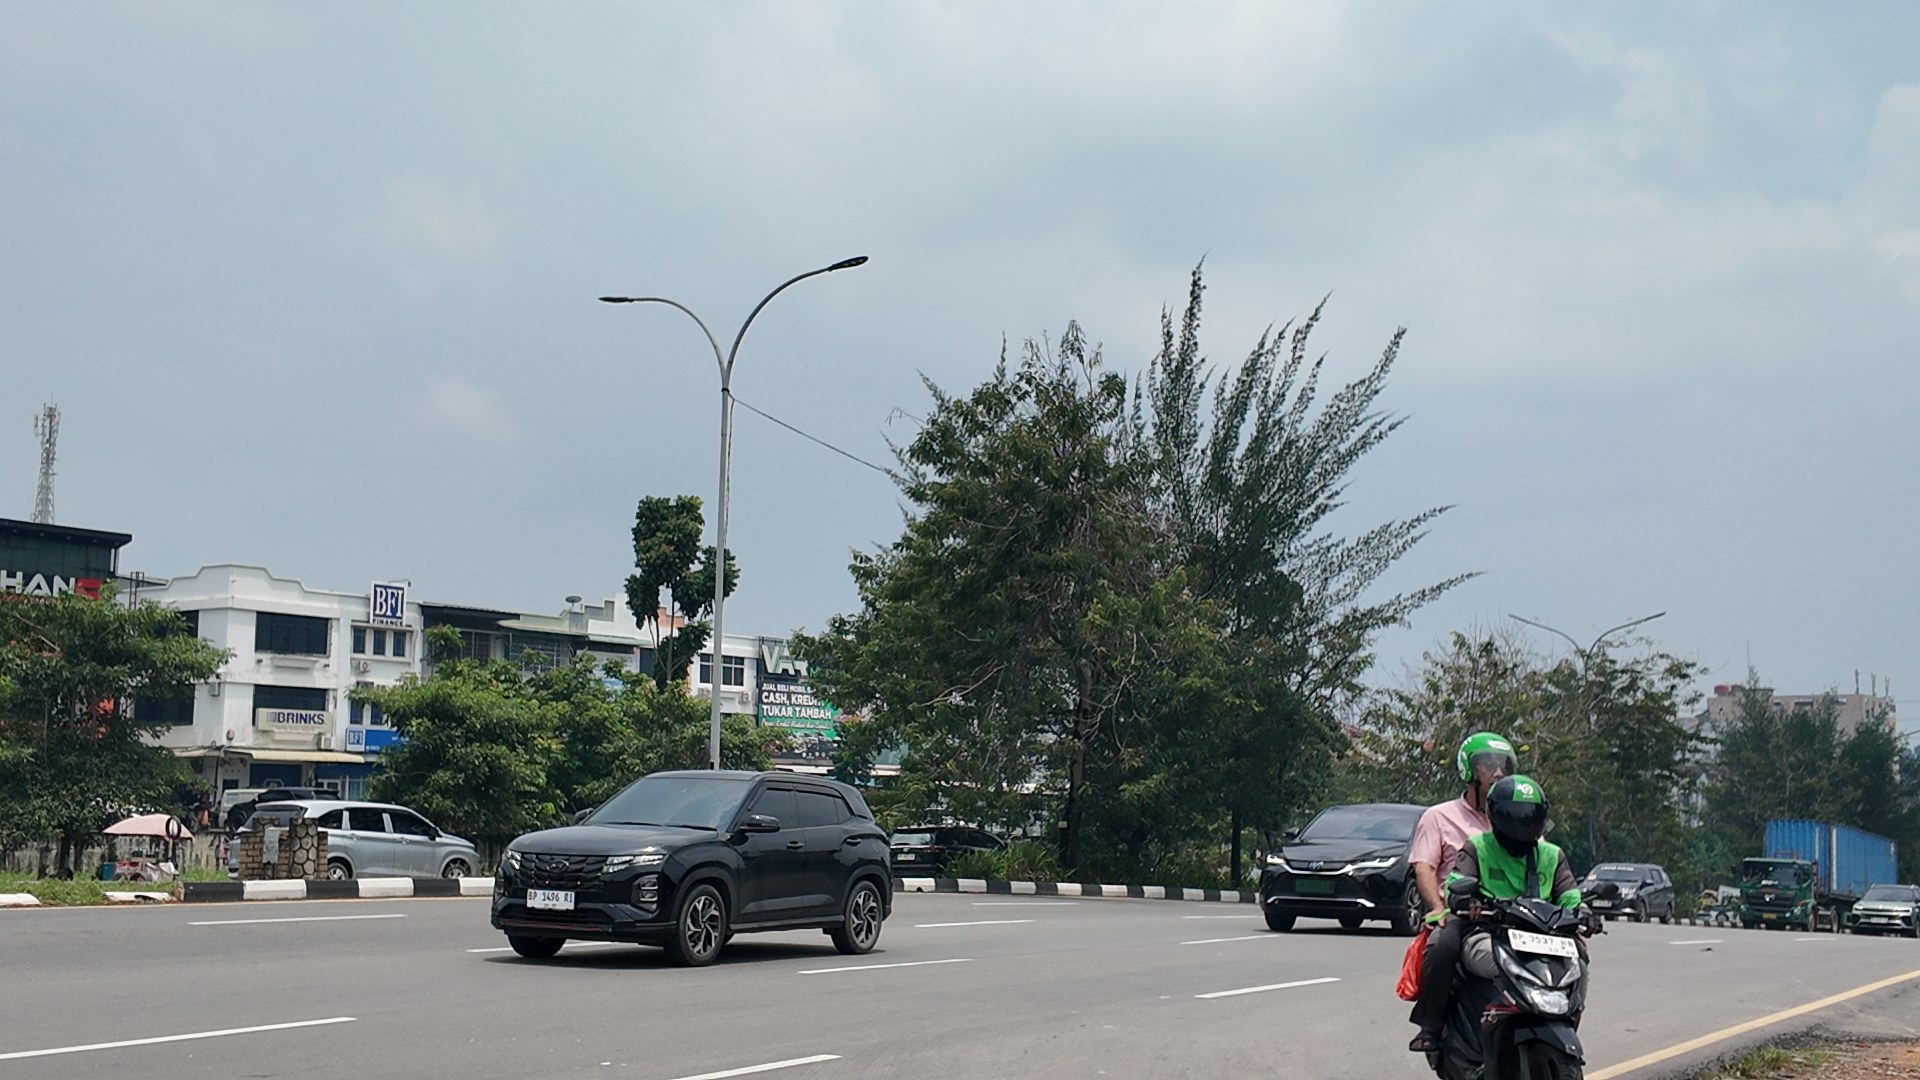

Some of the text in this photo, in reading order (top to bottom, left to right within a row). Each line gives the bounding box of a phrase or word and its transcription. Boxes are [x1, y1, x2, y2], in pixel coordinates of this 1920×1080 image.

[375, 586, 403, 617] BFI
[762, 692, 789, 705] CASH,
[277, 712, 325, 725] BRINKS
[762, 705, 832, 719] TUKAR TAMBAH
[529, 891, 538, 901] BP
